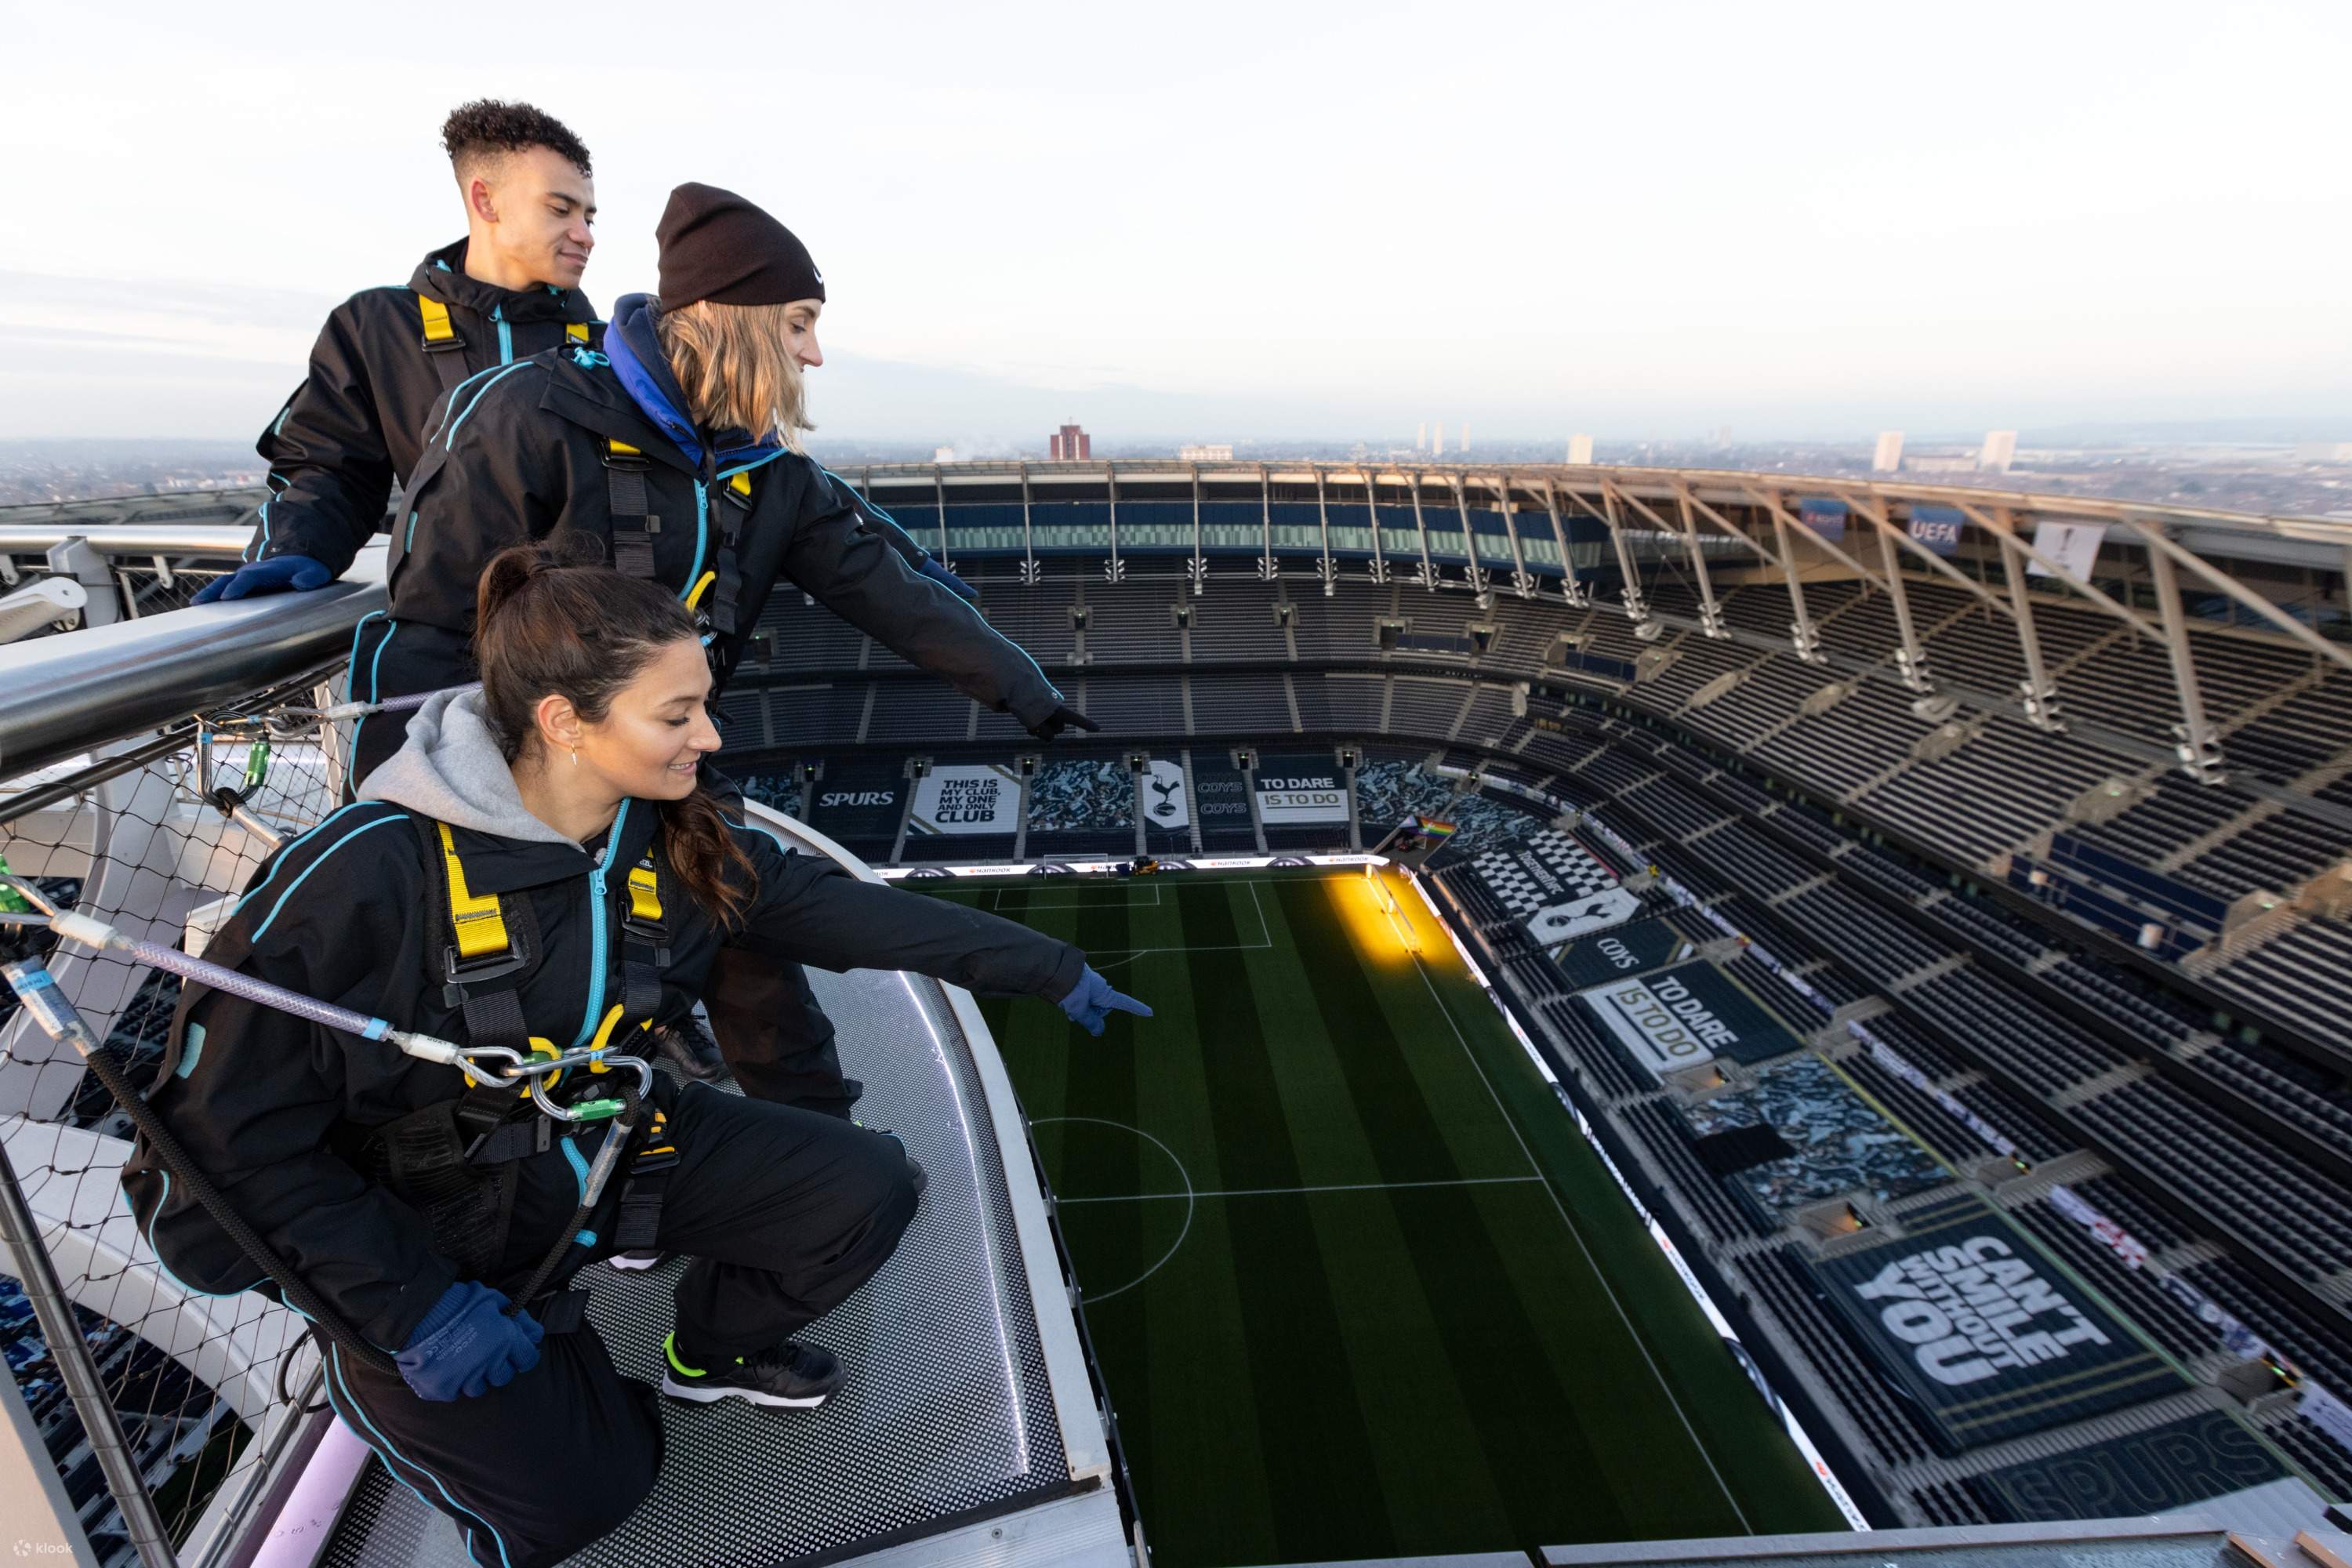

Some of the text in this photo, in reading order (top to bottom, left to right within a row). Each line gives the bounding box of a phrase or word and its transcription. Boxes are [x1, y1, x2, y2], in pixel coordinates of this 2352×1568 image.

[1911, 520, 1957, 542] UEFA
[943, 779, 998, 789] THIS IS
[1198, 782, 1243, 793] COYS
[1261, 778, 1335, 789] TO DARE
[819, 791, 894, 807] SPURS
[939, 795, 997, 804] MY ONE
[1200, 803, 1247, 815] COYS
[1265, 793, 1339, 805] IS TO DO
[935, 810, 995, 823] CLUB
[1597, 937, 1640, 969] COYS
[1617, 987, 1699, 1057] IS TO DO
[1651, 976, 1740, 1049] TO DARE
[1962, 1236, 2113, 1347] CAN'T
[1896, 1254, 2030, 1369] WITHOUT
[1921, 1245, 2071, 1367] SMILE
[1853, 1261, 2000, 1386] YOU
[2001, 1416, 2272, 1519] SPURS
